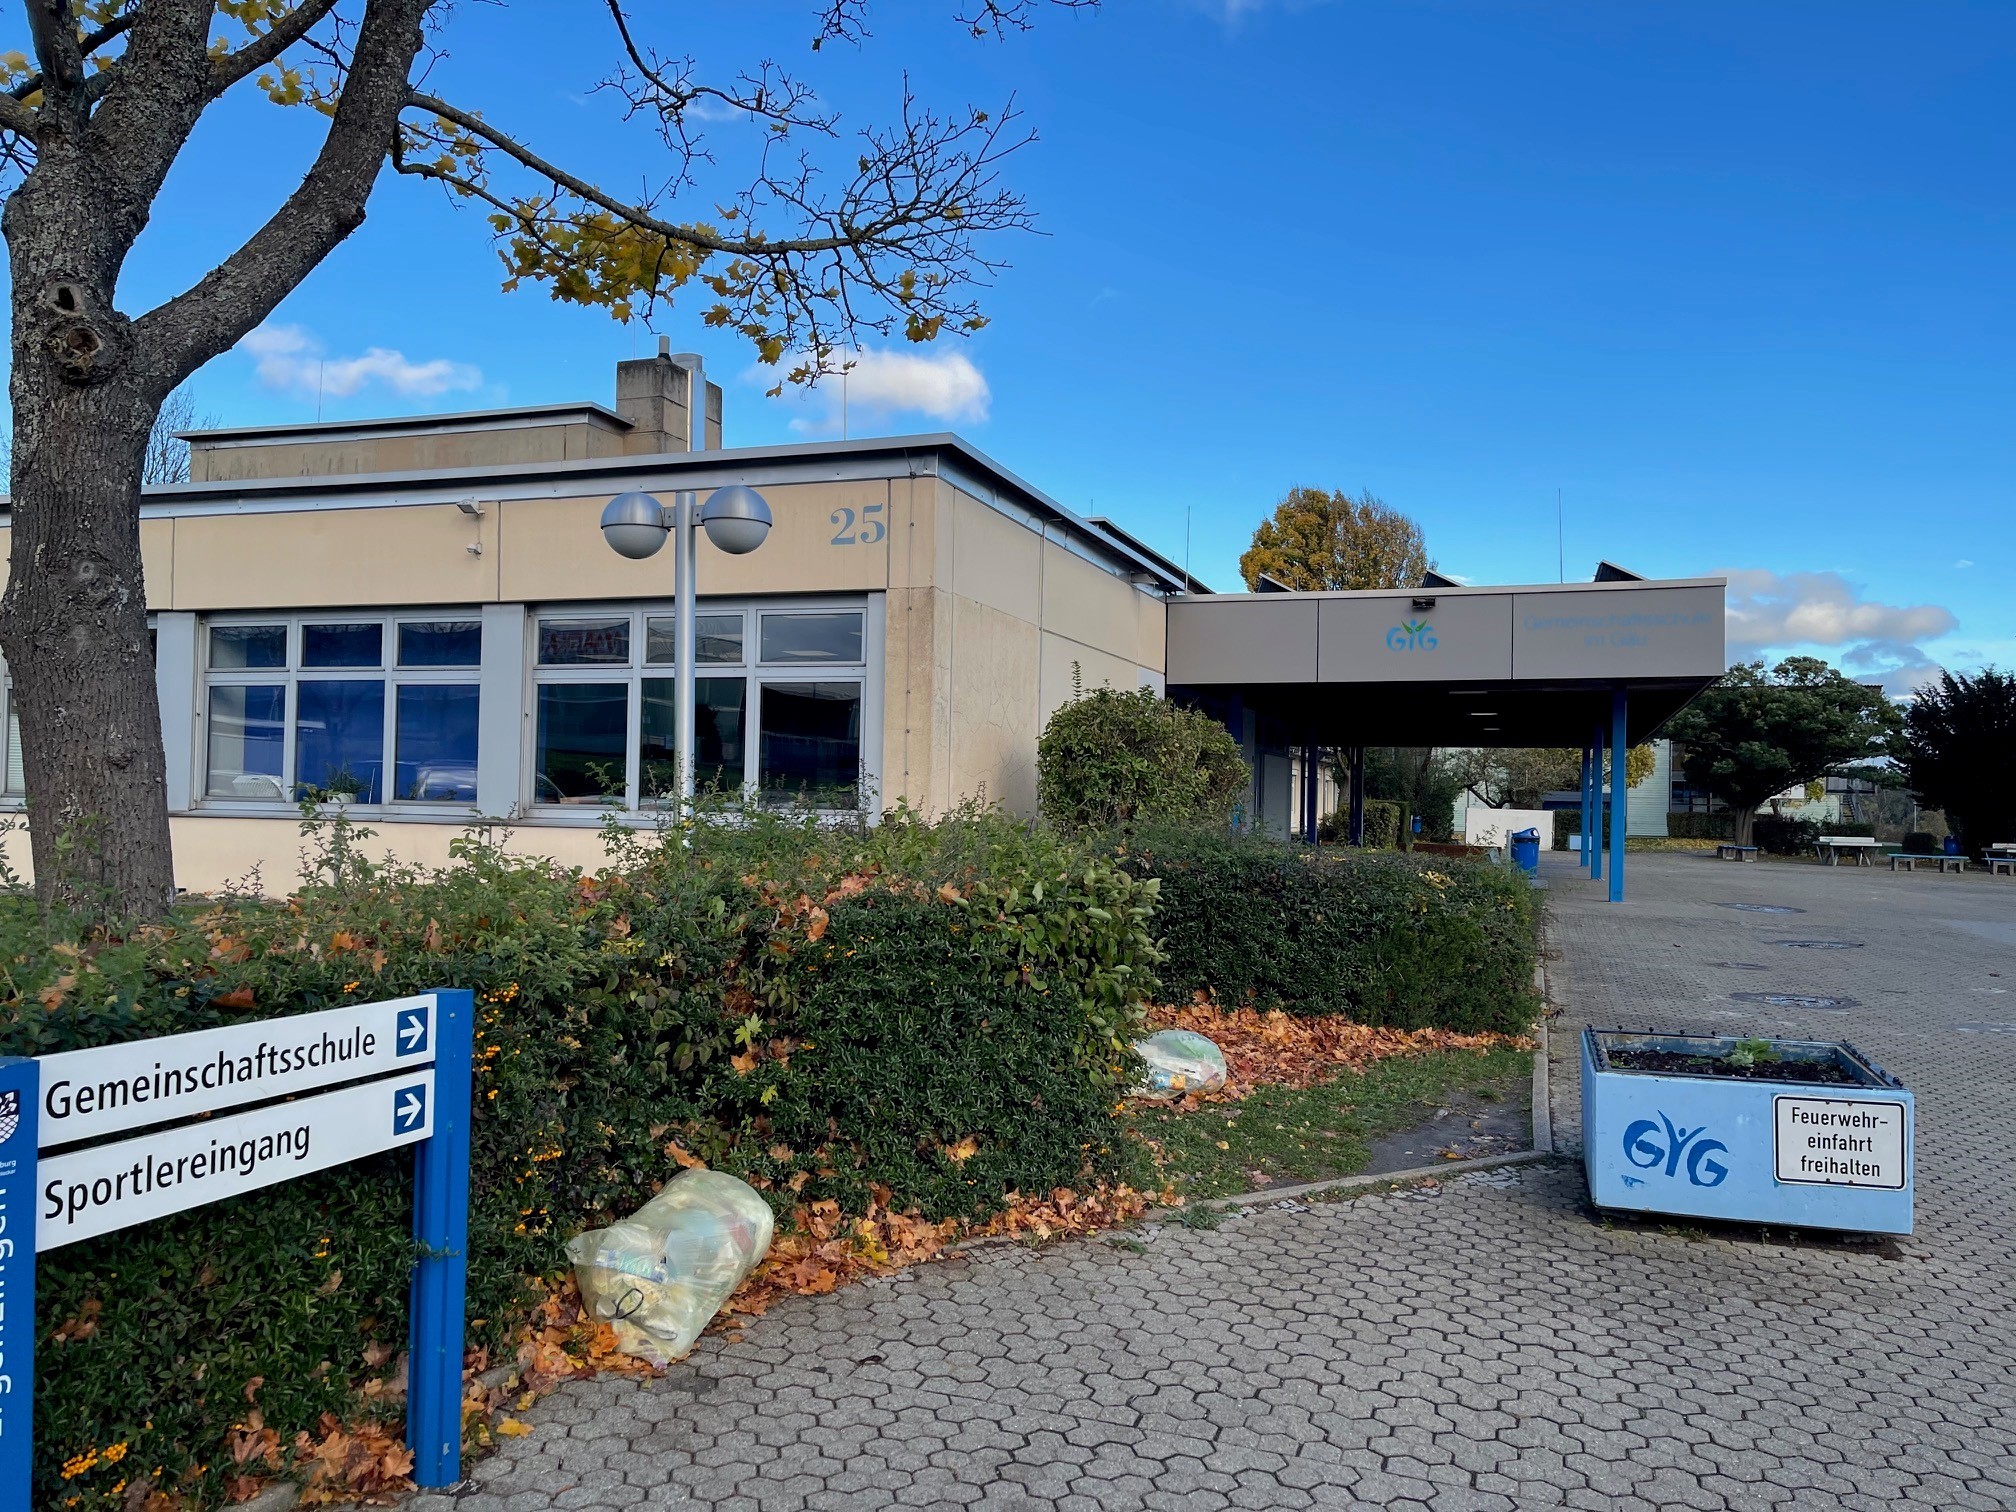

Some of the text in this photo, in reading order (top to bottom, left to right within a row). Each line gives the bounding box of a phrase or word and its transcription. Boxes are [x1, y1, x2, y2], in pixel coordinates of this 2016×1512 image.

[830, 503, 885, 545] 25
[46, 1026, 376, 1119] Gemeinschaftsschule
[1791, 1106, 1888, 1129] Feuerwehr-
[1807, 1133, 1873, 1152] einfahrt
[45, 1123, 310, 1224] Sportlereingang
[1800, 1155, 1881, 1177] freihalten
